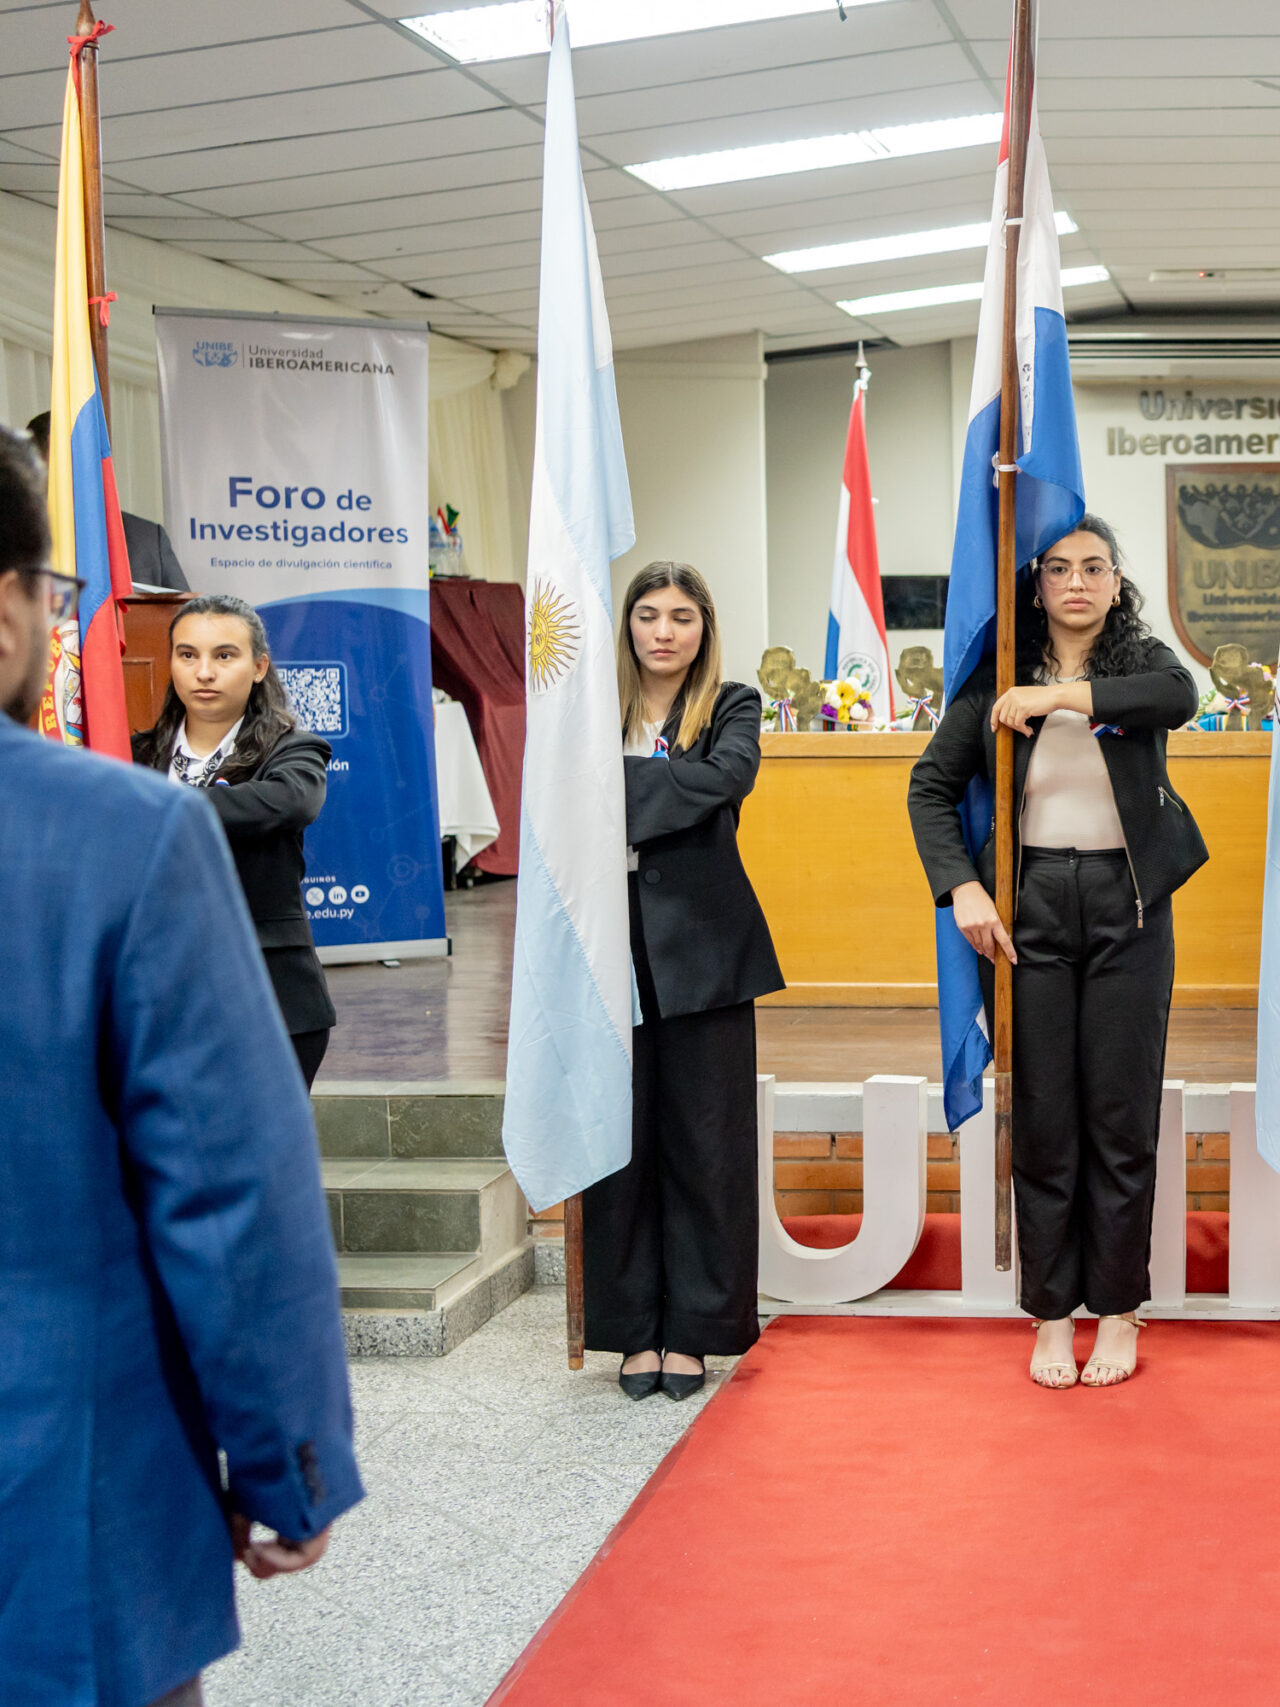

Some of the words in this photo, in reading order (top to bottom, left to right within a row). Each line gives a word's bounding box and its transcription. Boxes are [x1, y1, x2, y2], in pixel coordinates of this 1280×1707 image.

[196, 341, 233, 352] UNIBE
[249, 345, 323, 359] Universidad
[249, 358, 395, 376] IBEROAMERICANA
[229, 476, 326, 510] Foro
[336, 489, 372, 511] de
[190, 517, 409, 548] Investigadores
[210, 557, 255, 570] Espacio
[258, 558, 273, 569] de
[276, 557, 340, 571] divulgación
[324, 758, 350, 772] ión
[306, 907, 355, 920] e.edu.py
